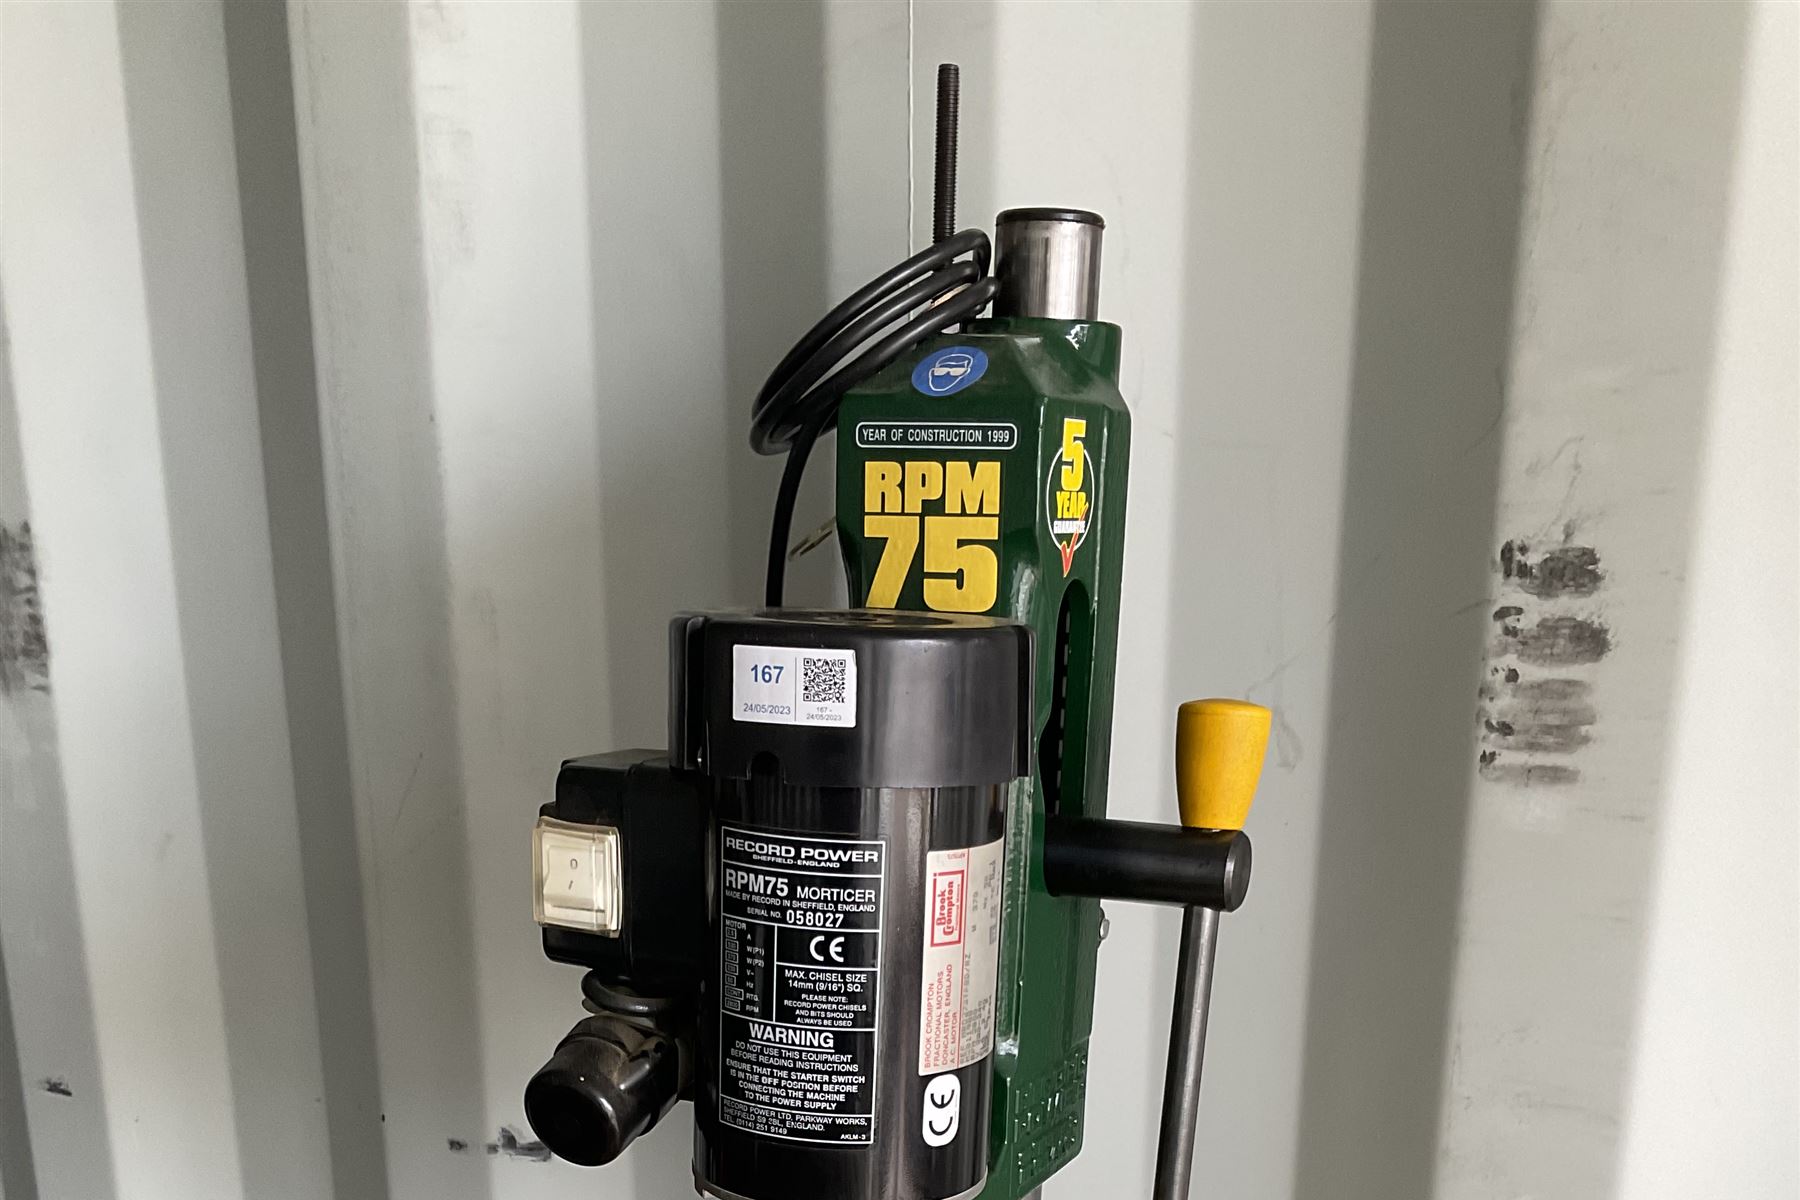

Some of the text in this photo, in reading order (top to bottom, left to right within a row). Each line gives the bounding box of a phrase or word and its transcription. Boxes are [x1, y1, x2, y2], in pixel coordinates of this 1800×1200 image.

[862, 429, 1009, 443] YEAR OF CONSTRUCTION 1999
[1061, 418, 1086, 492] 5
[864, 461, 1001, 514] RPM
[1056, 491, 1086, 519] YEAR
[864, 515, 999, 613] 75
[751, 664, 784, 683] 167
[743, 703, 791, 715] 24/05/2023
[726, 837, 878, 863] RECORD POWER
[726, 869, 876, 902] RPM75 MORTICER
[726, 889, 876, 912] MADE BY RECORD IN SHEFFIELD, ENGLAND
[936, 889, 947, 926] Brook
[943, 881, 955, 936] Crompton
[725, 919, 746, 930] MOTOR
[747, 907, 844, 928] SERIAL NO. 058027
[809, 935, 845, 963] CE
[785, 969, 867, 983] MAX. CHISEL SIZE
[788, 980, 814, 990] 14mm
[846, 983, 863, 993] SQ.
[784, 1000, 811, 1009] RECORD
[801, 994, 848, 1003] PLEASE NOTE:
[795, 1009, 809, 1017] AND
[827, 1011, 854, 1019] SHOULD
[796, 1017, 822, 1026] ALWAYS
[924, 982, 935, 1068] BROOK CROMPTON
[933, 971, 944, 1068] FRACTIONAL MOTORS
[749, 1022, 834, 1047] WARNING
[730, 1049, 859, 1072] BEFORE READING INSTRUCTIONS
[735, 1040, 852, 1062] DO NOT USE THIS EQUIPMENT
[726, 1058, 866, 1084] ENSURE THAT THE STARTER SWITCH
[730, 1069, 737, 1077] IS
[737, 1070, 745, 1079] IN
[746, 1072, 760, 1082] THE
[781, 1079, 820, 1091] POSITION
[823, 1083, 858, 1093] BEFORE
[738, 1080, 845, 1102] CONNECTING THE MACHINE
[744, 1090, 837, 1110] TO THE POWER SUPPLY
[750, 1104, 776, 1117] POWER
[777, 1111, 793, 1121] LTD.
[795, 1115, 832, 1124] PARKWAY
[835, 1117, 867, 1126] WORKS,
[928, 1089, 955, 1136] CE
[786, 1121, 825, 1132] ENGLAND.
